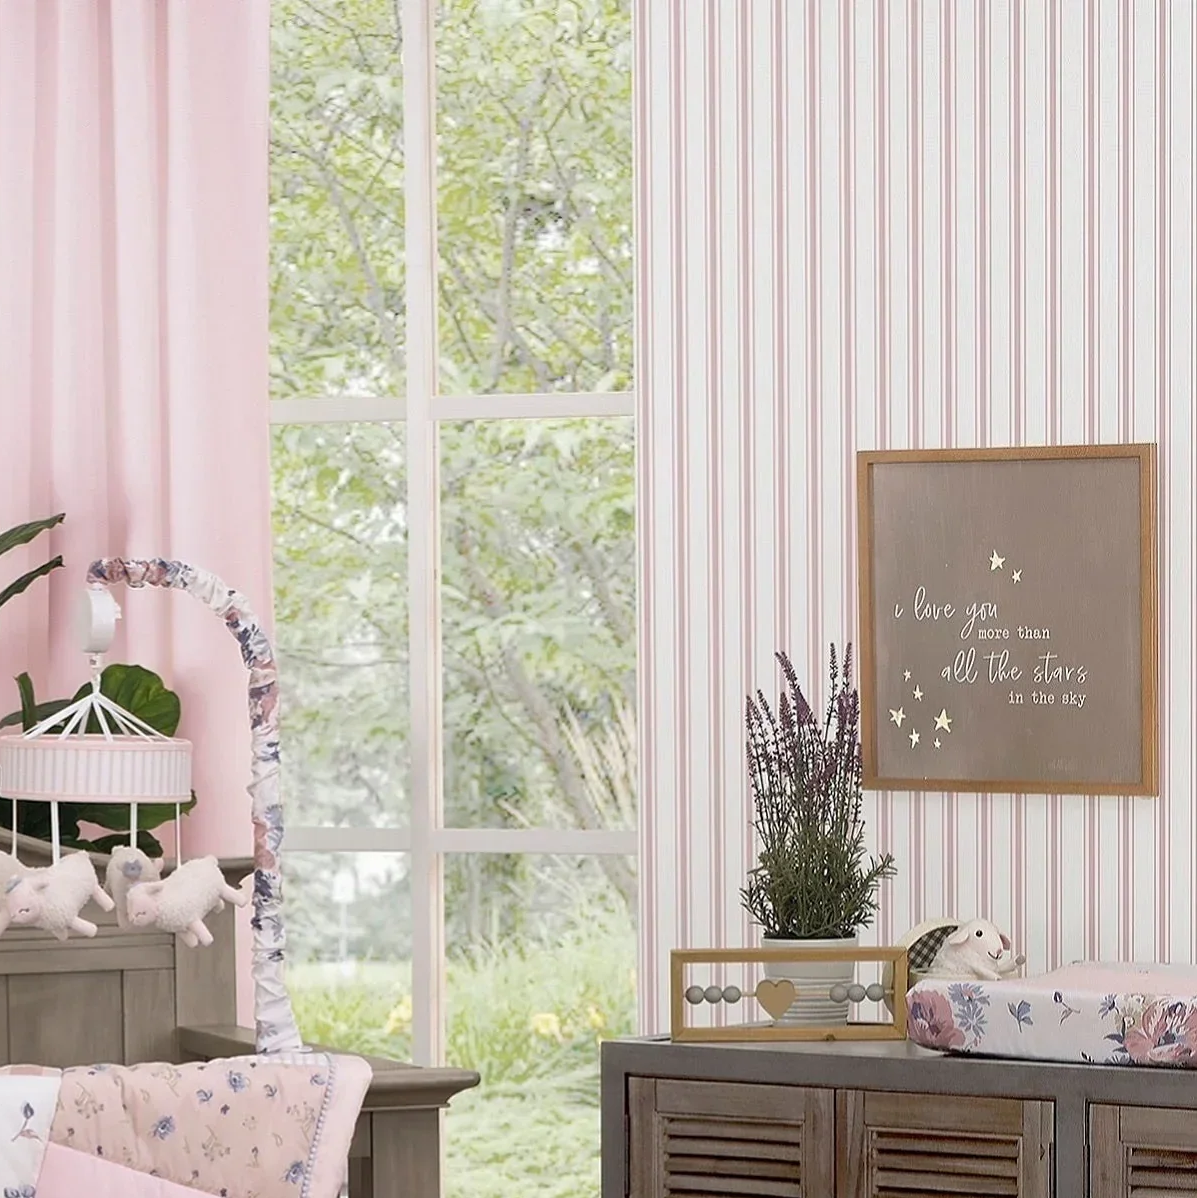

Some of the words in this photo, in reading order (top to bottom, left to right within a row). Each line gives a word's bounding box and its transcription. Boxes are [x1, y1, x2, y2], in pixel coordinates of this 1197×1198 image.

[894, 602, 903, 620] i
[913, 586, 956, 621] love
[960, 602, 998, 640] you
[978, 627, 1009, 640] more
[1017, 625, 1050, 640] than
[940, 647, 978, 684] all
[983, 650, 1022, 684] the
[1033, 652, 1088, 684] stars
[1008, 690, 1023, 704] in
[1031, 690, 1055, 705] the
[1062, 690, 1086, 708] sky
